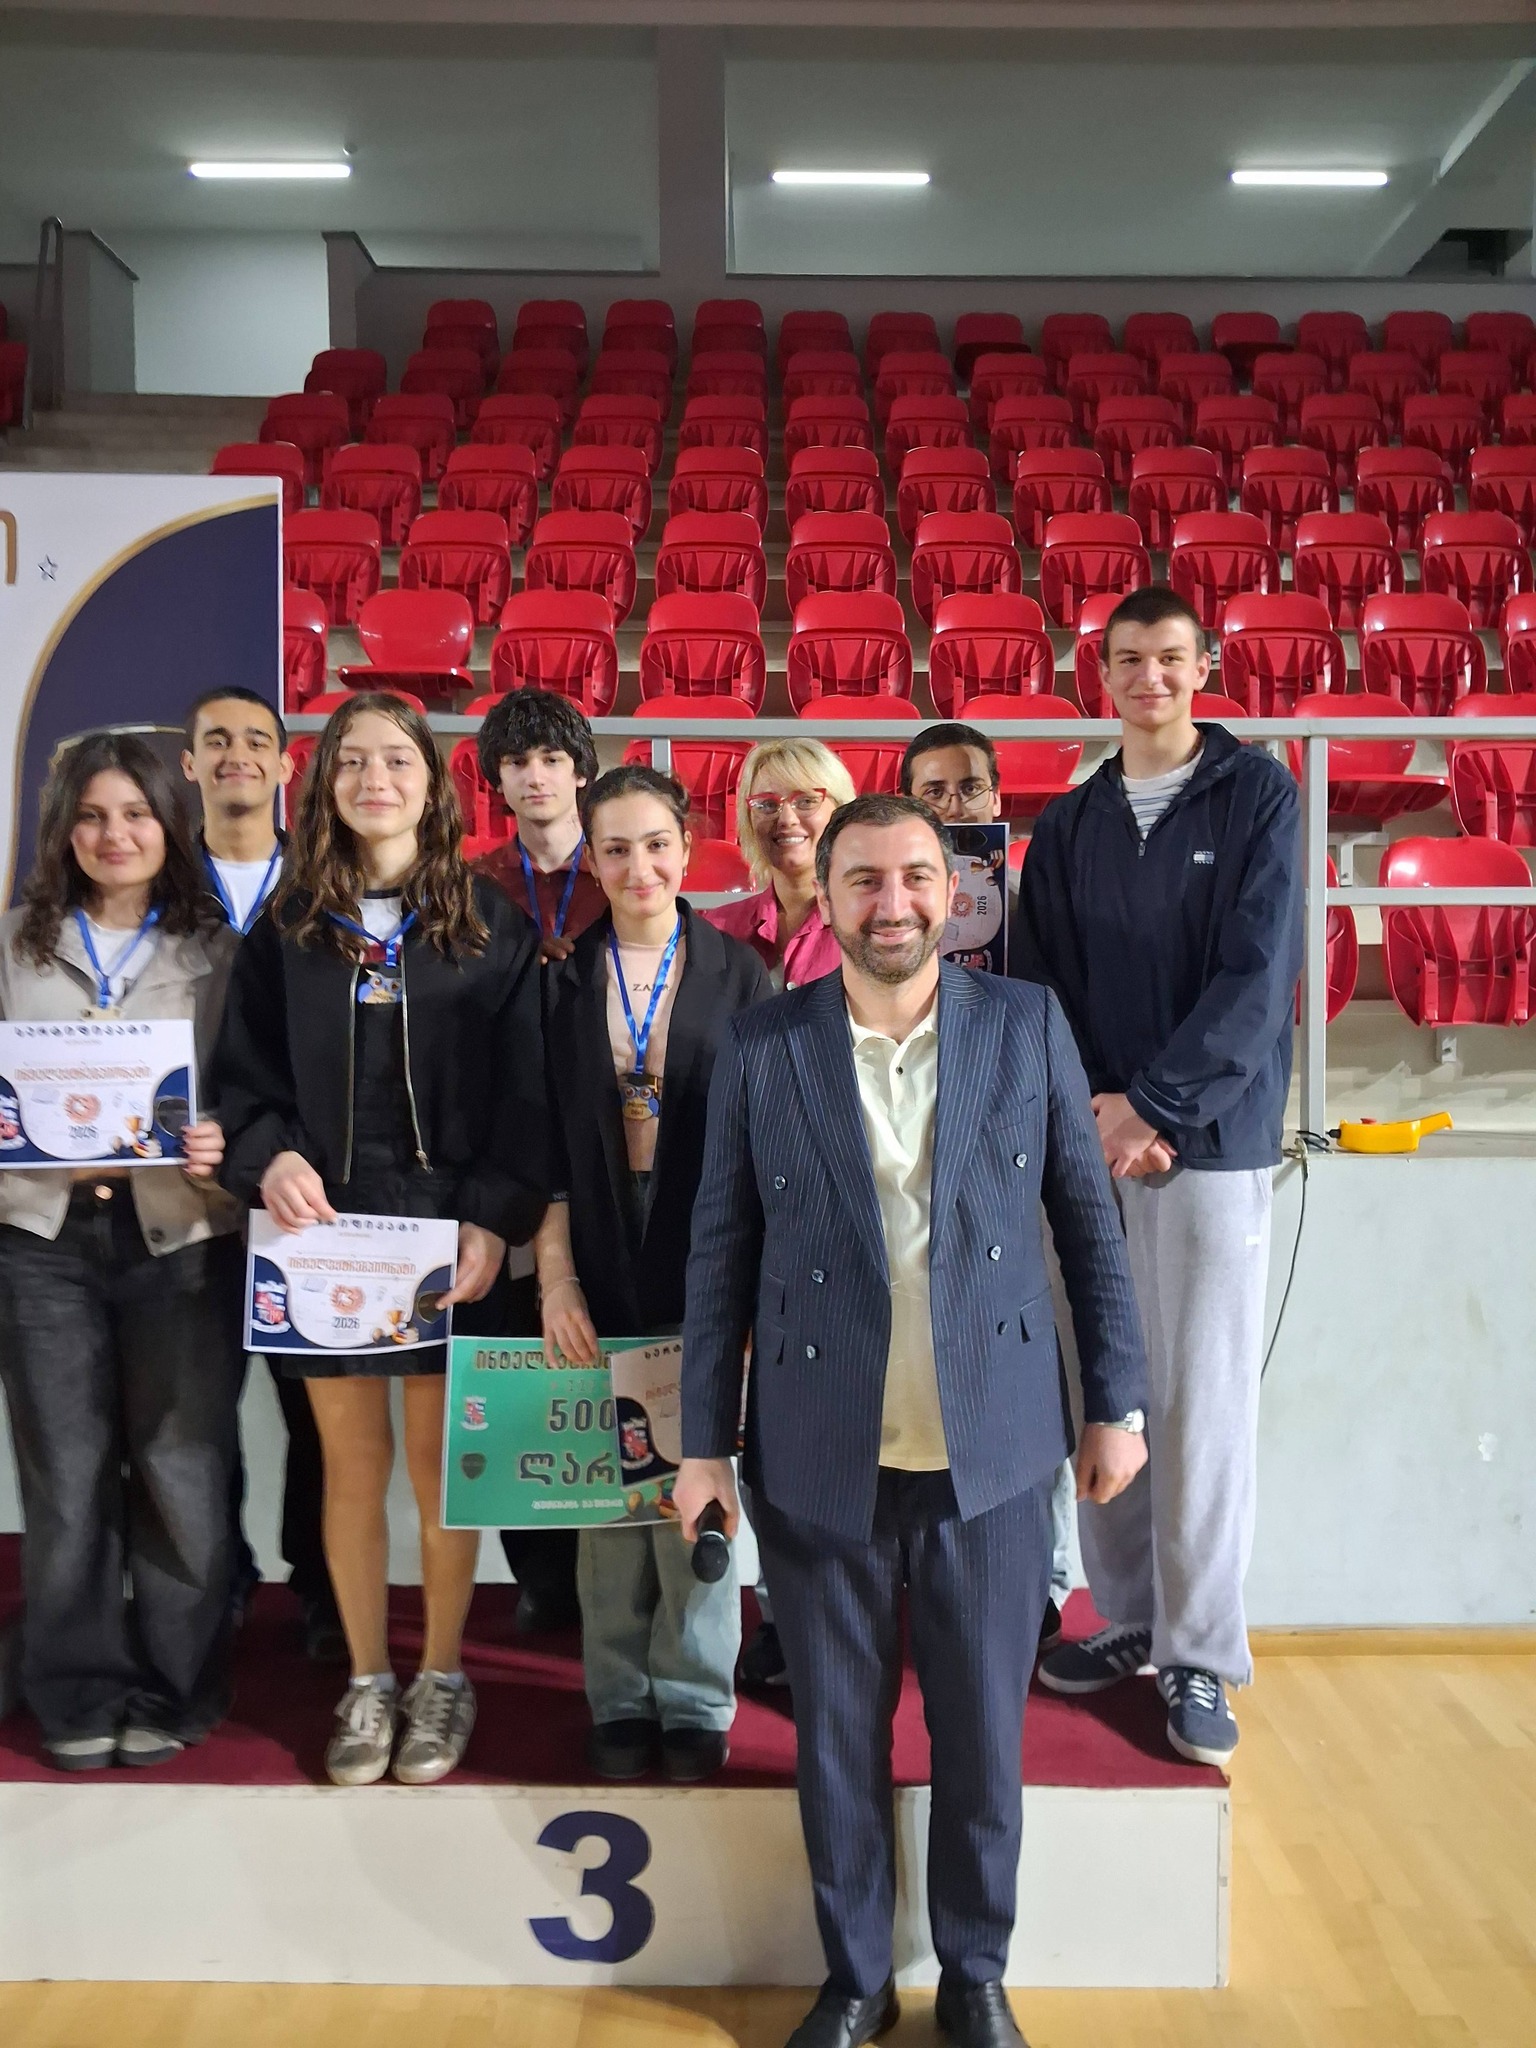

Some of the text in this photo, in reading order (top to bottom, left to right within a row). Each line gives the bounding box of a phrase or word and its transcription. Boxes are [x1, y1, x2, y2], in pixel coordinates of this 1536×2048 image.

[976, 895, 988, 916] 2026
[633, 983, 671, 992] ZAA
[550, 1398, 616, 1432] 500
[519, 1452, 616, 1486] ლარ
[529, 1810, 656, 1964] 3
